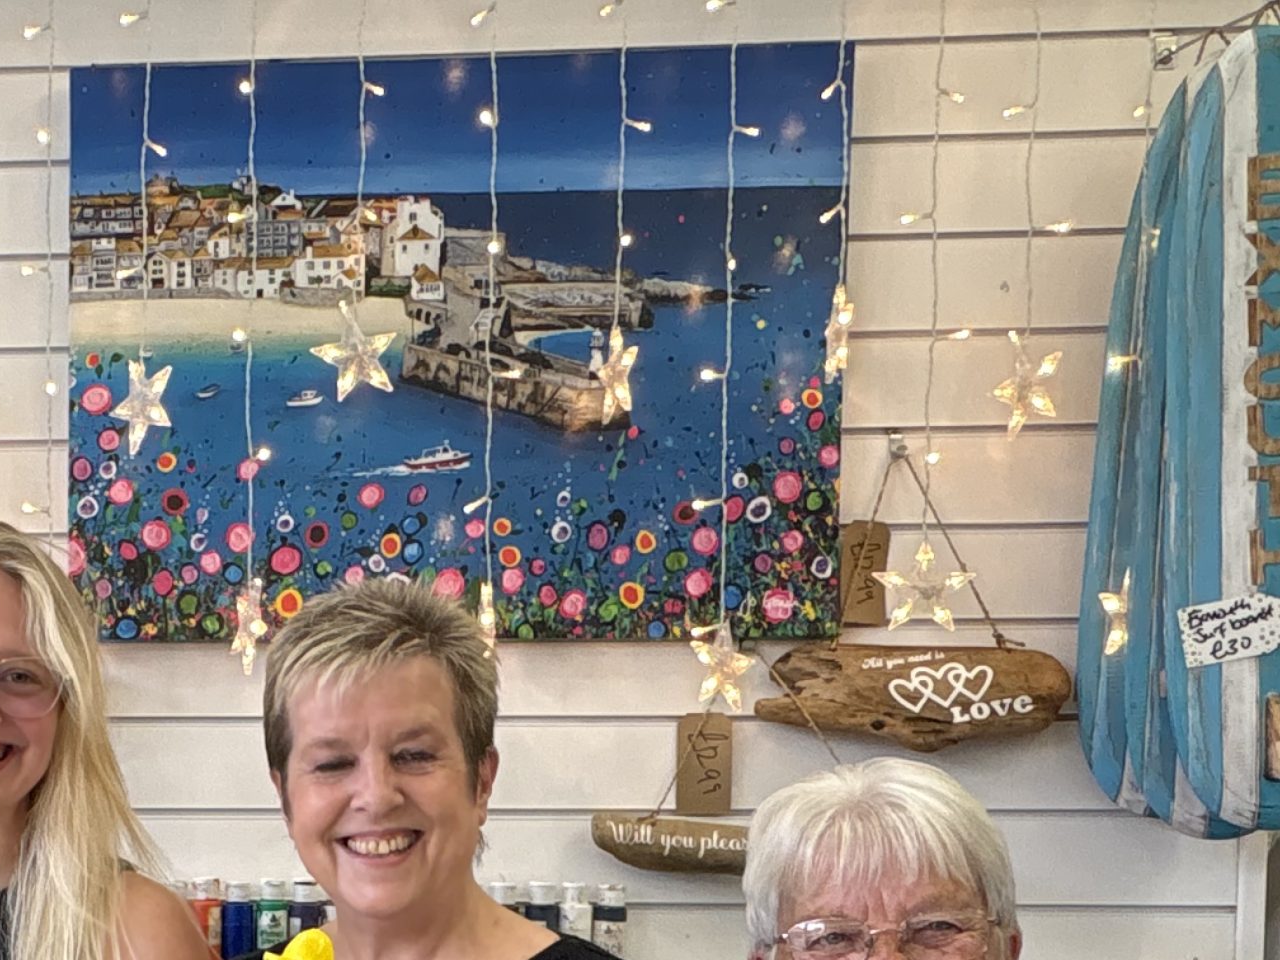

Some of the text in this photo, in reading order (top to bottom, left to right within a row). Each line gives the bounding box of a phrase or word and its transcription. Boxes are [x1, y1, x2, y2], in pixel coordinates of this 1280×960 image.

[1209, 636, 1252, 659] £30
[886, 657, 905, 670] you
[907, 651, 932, 663] need
[934, 650, 945, 660] is
[606, 820, 655, 846] Will
[660, 833, 697, 857] you
